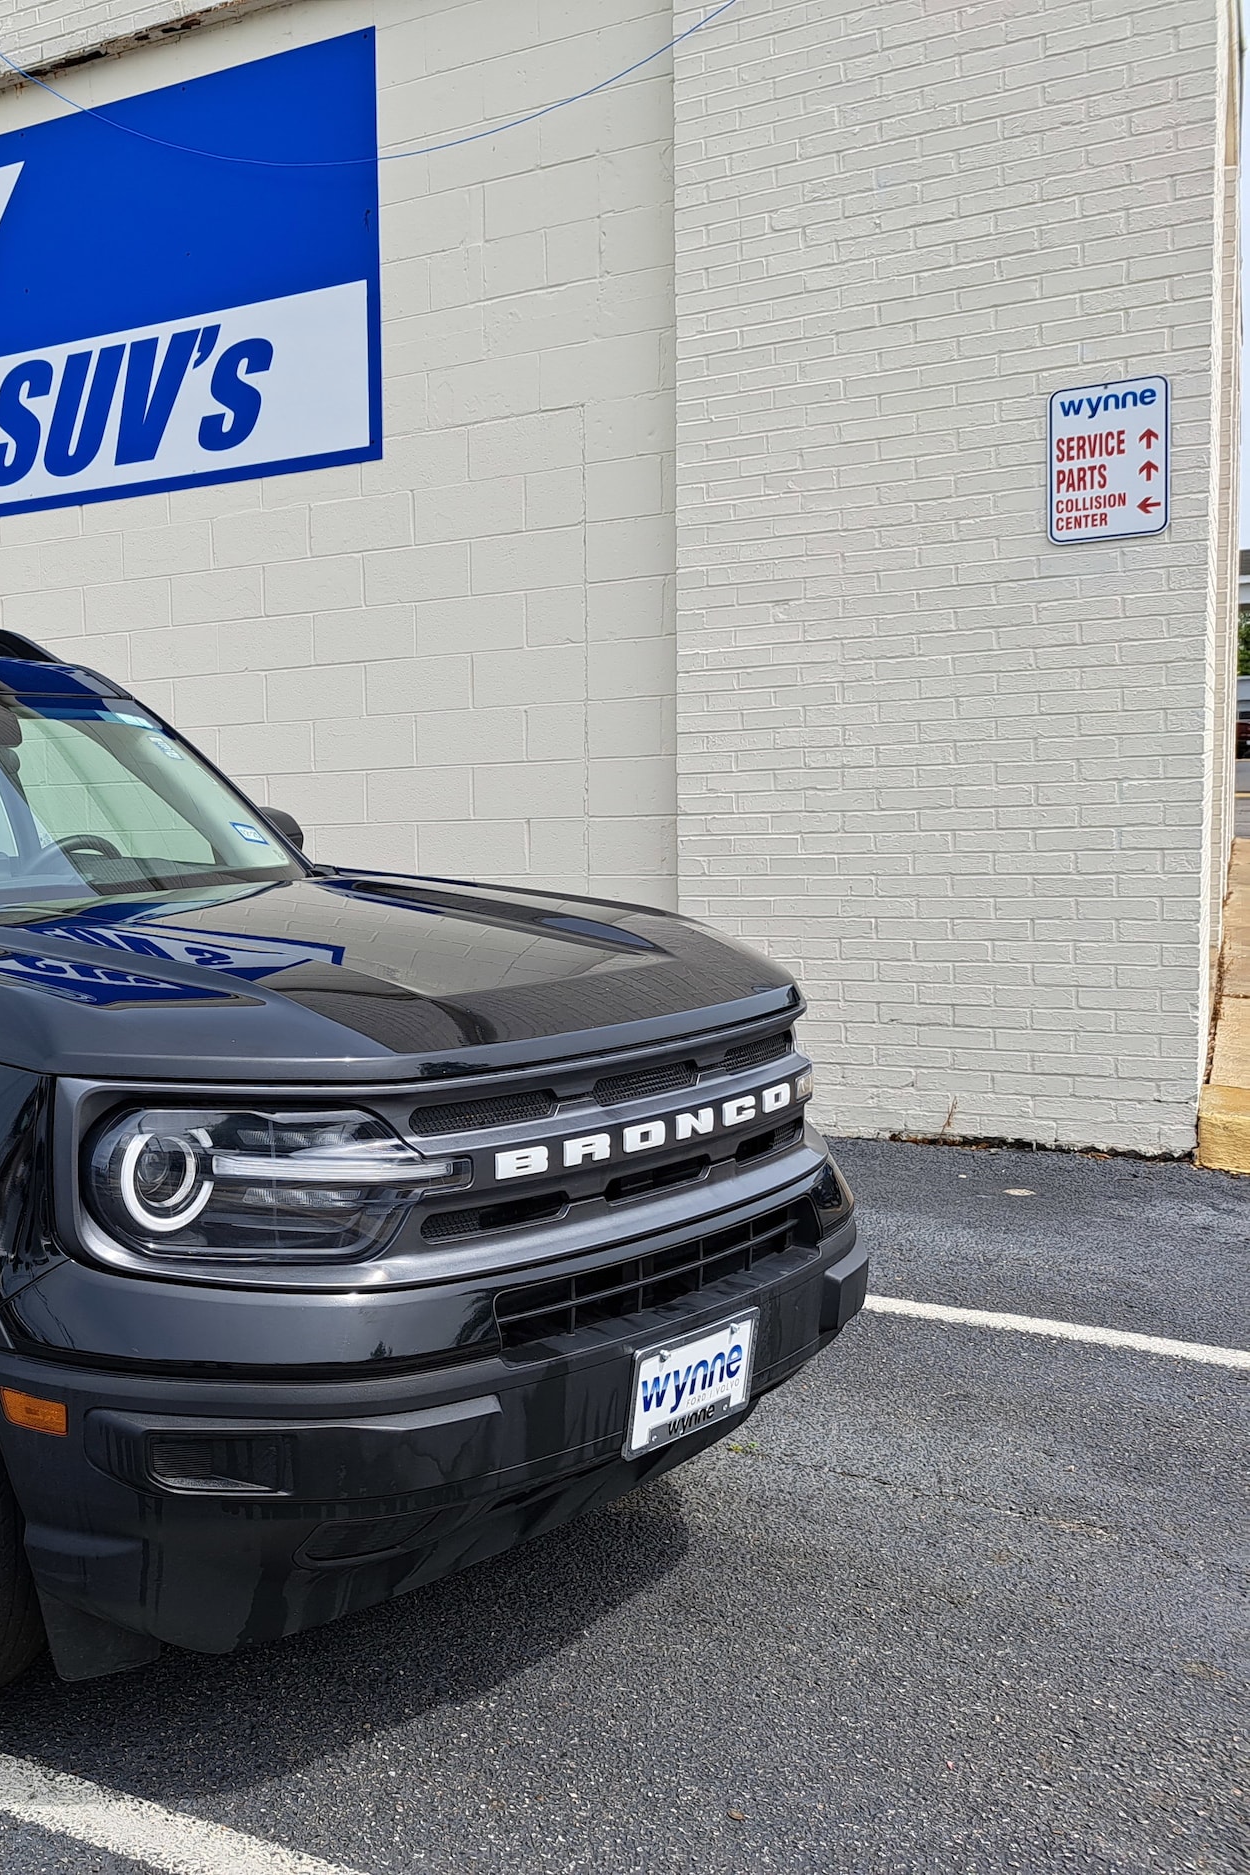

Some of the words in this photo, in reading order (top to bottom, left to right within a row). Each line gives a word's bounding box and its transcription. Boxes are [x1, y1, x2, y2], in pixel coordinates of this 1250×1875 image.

[1059, 387, 1157, 420] wynne
[1056, 429, 1126, 463] SERVICE
[1056, 463, 1107, 494] PARTS
[1056, 492, 1127, 514] COLLISION
[1056, 512, 1108, 532] CENTER
[494, 1082, 791, 1181] BRONCO
[641, 1344, 743, 1414] wynne
[686, 1392, 707, 1408] FORD
[716, 1378, 740, 1395] VOLVO
[668, 1404, 716, 1436] wynne
